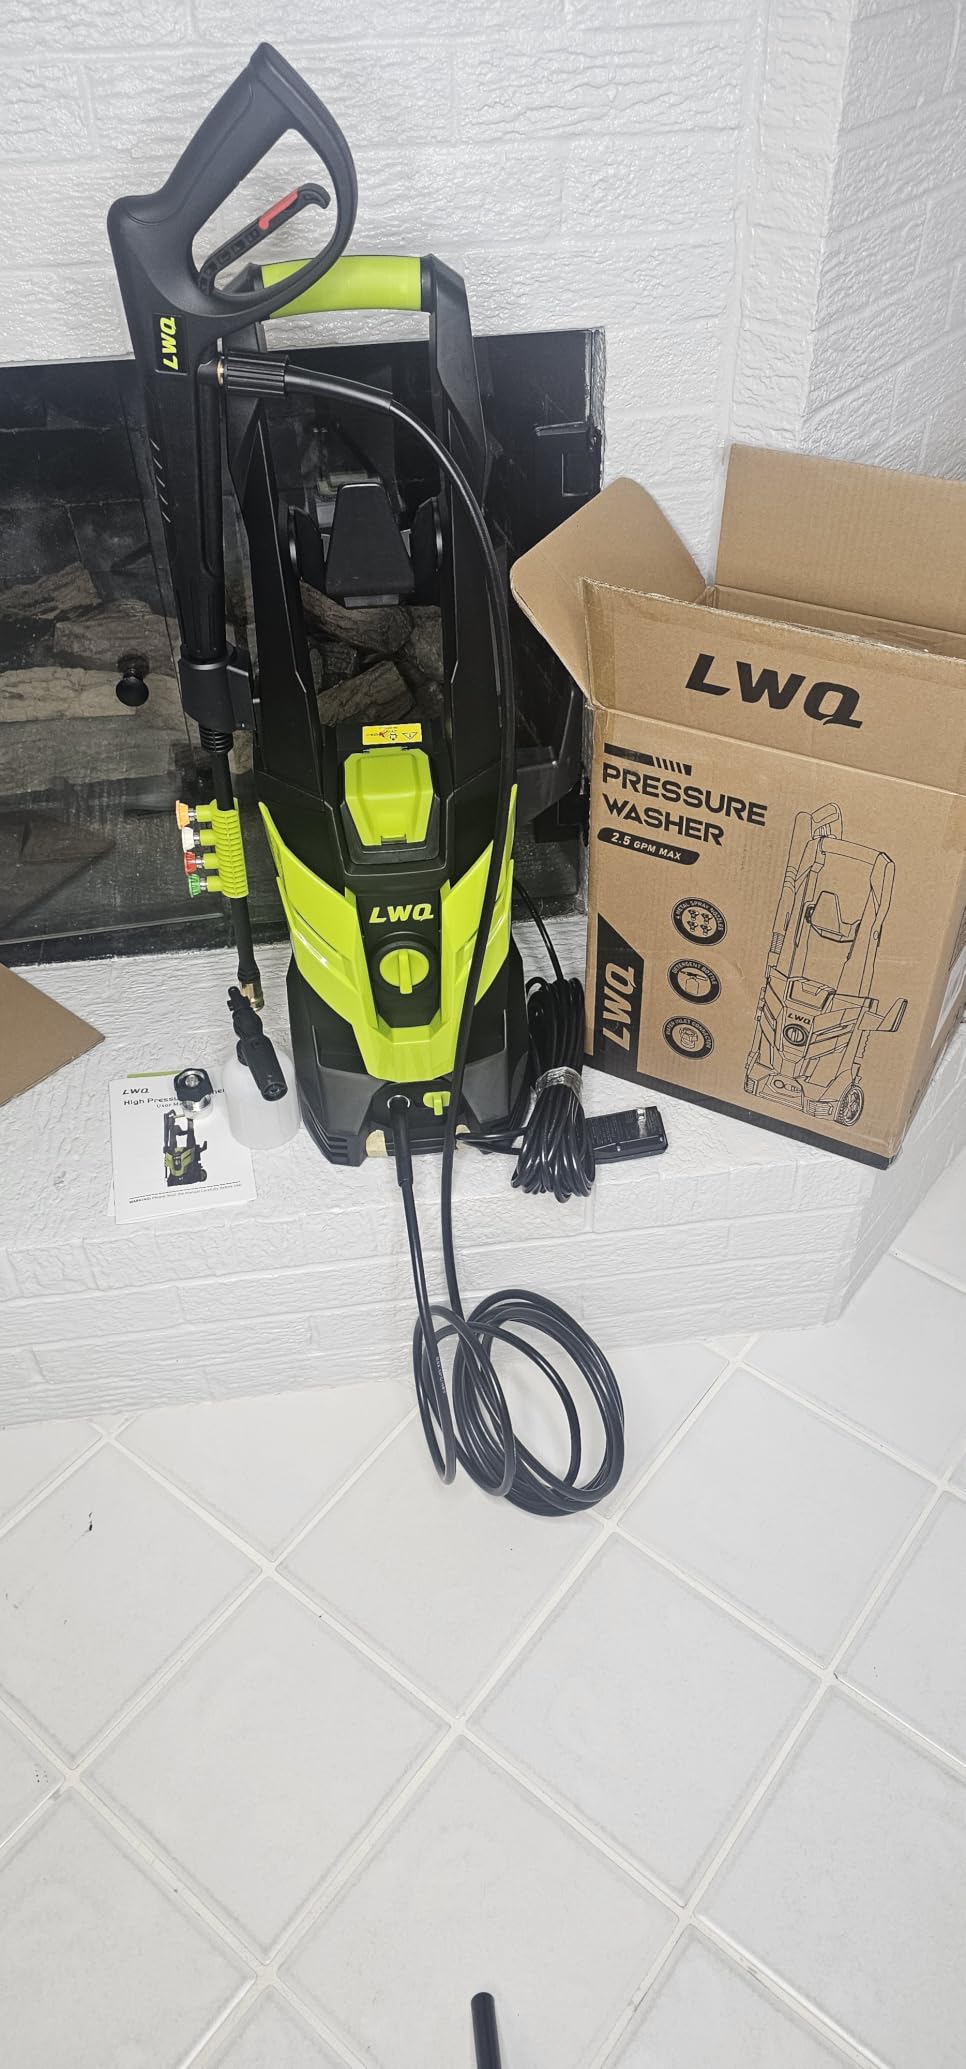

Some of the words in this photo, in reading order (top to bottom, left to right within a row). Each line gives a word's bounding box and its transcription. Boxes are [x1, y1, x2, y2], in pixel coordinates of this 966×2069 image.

[159, 316, 179, 370] LWQ
[685, 653, 863, 729] LWQ
[602, 762, 768, 826] PRESSURE
[602, 793, 724, 846] WASHER
[611, 832, 631, 845] 2.5
[633, 841, 656, 853] GPM
[659, 847, 682, 860] MAX
[369, 903, 434, 924] LWQ
[701, 967, 718, 985] BOTTLE
[603, 963, 637, 1051] LWQ
[787, 1013, 811, 1025] LWQ
